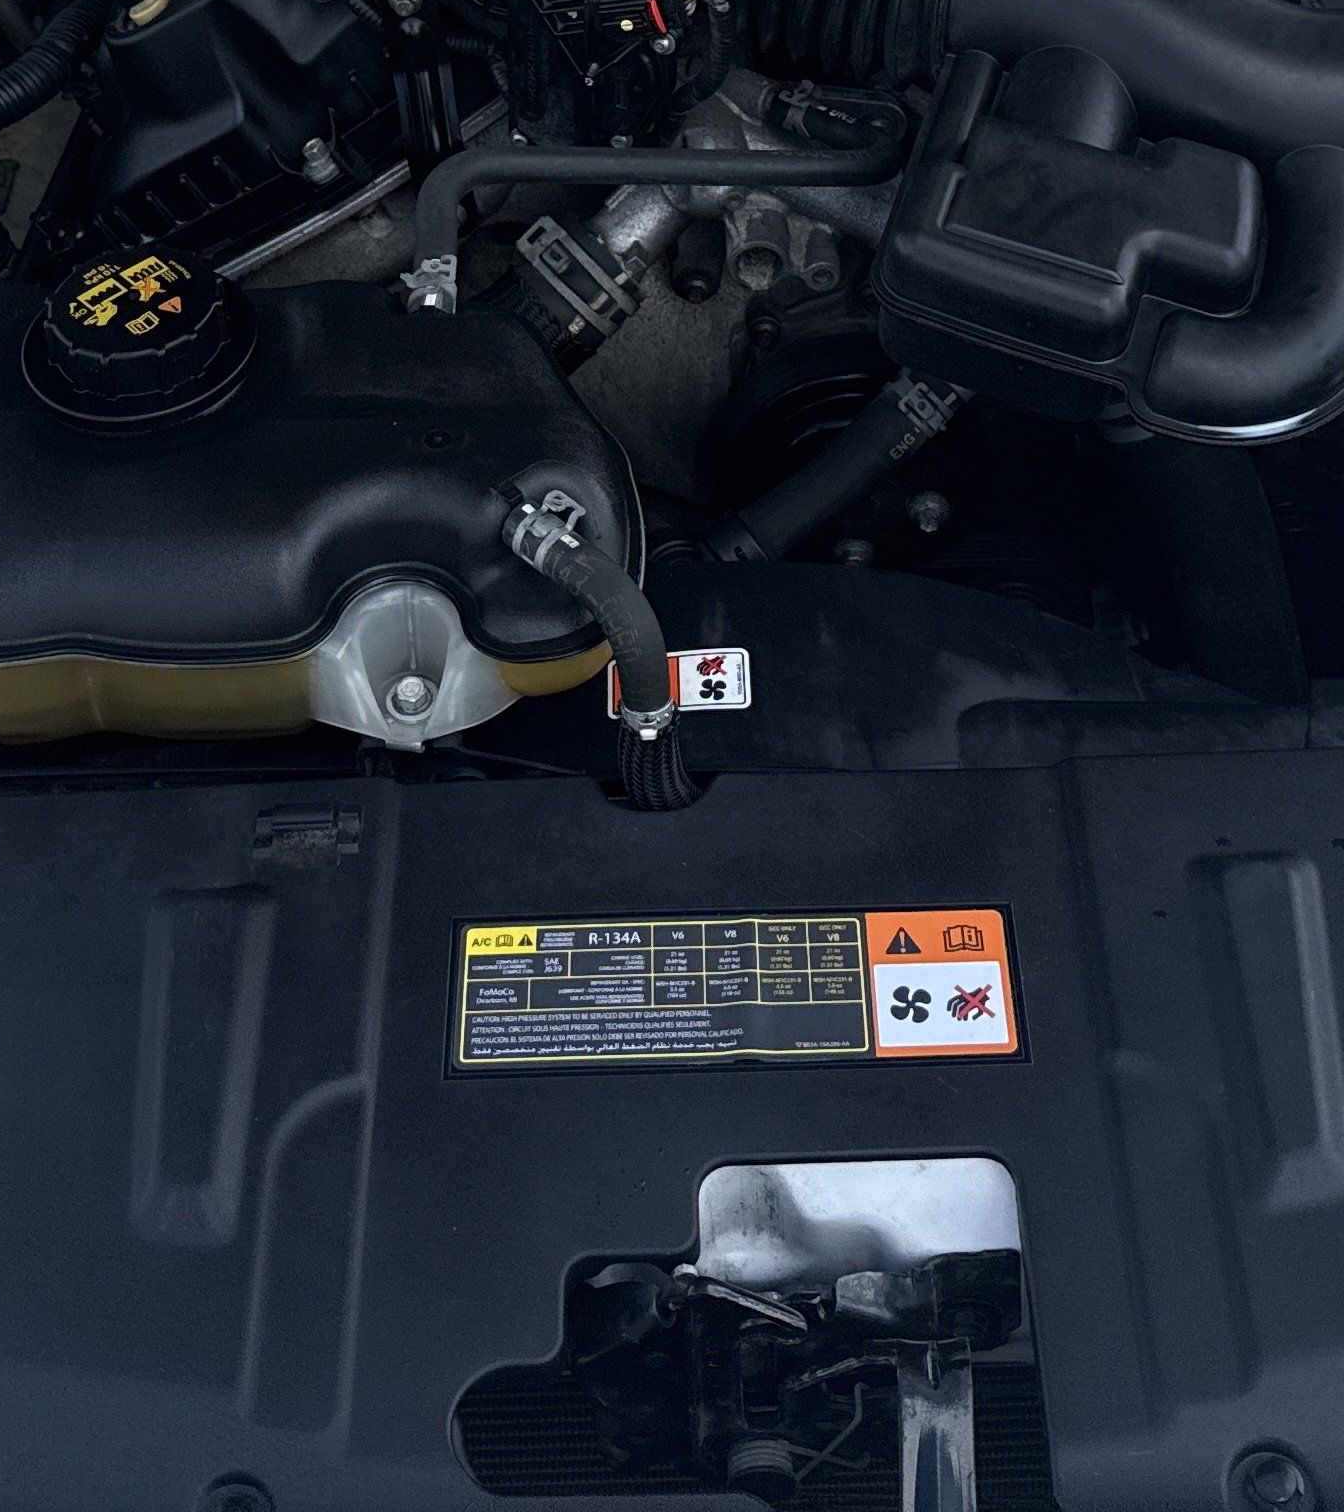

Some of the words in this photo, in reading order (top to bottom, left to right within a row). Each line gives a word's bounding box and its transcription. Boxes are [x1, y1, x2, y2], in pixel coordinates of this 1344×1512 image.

[71, 308, 88, 320] OK
[889, 432, 916, 461] ENG
[587, 931, 642, 946] R-134A
[671, 930, 685, 940] V6
[724, 929, 737, 939] V8
[776, 934, 789, 943] V6
[827, 932, 840, 942] V8
[471, 938, 492, 948] A/C
[544, 957, 560, 966] SAE
[478, 988, 515, 997] FoMoCo
[518, 1014, 547, 1022] PRESSURE
[548, 1013, 571, 1021] SYSTEM
[590, 1012, 618, 1020] SERVICED
[618, 1011, 634, 1019] ONLY
[643, 1010, 675, 1019] QUALIFIED
[508, 1025, 532, 1033] CIRCUIT
[570, 1023, 600, 1031] PRESSION
[605, 1022, 643, 1030] TECHNICIENS
[517, 1035, 542, 1043] SISTEMA
[608, 1032, 623, 1040] DEBE
[635, 1031, 664, 1039] REVISADO
[678, 1030, 708, 1038] PERSONAL
